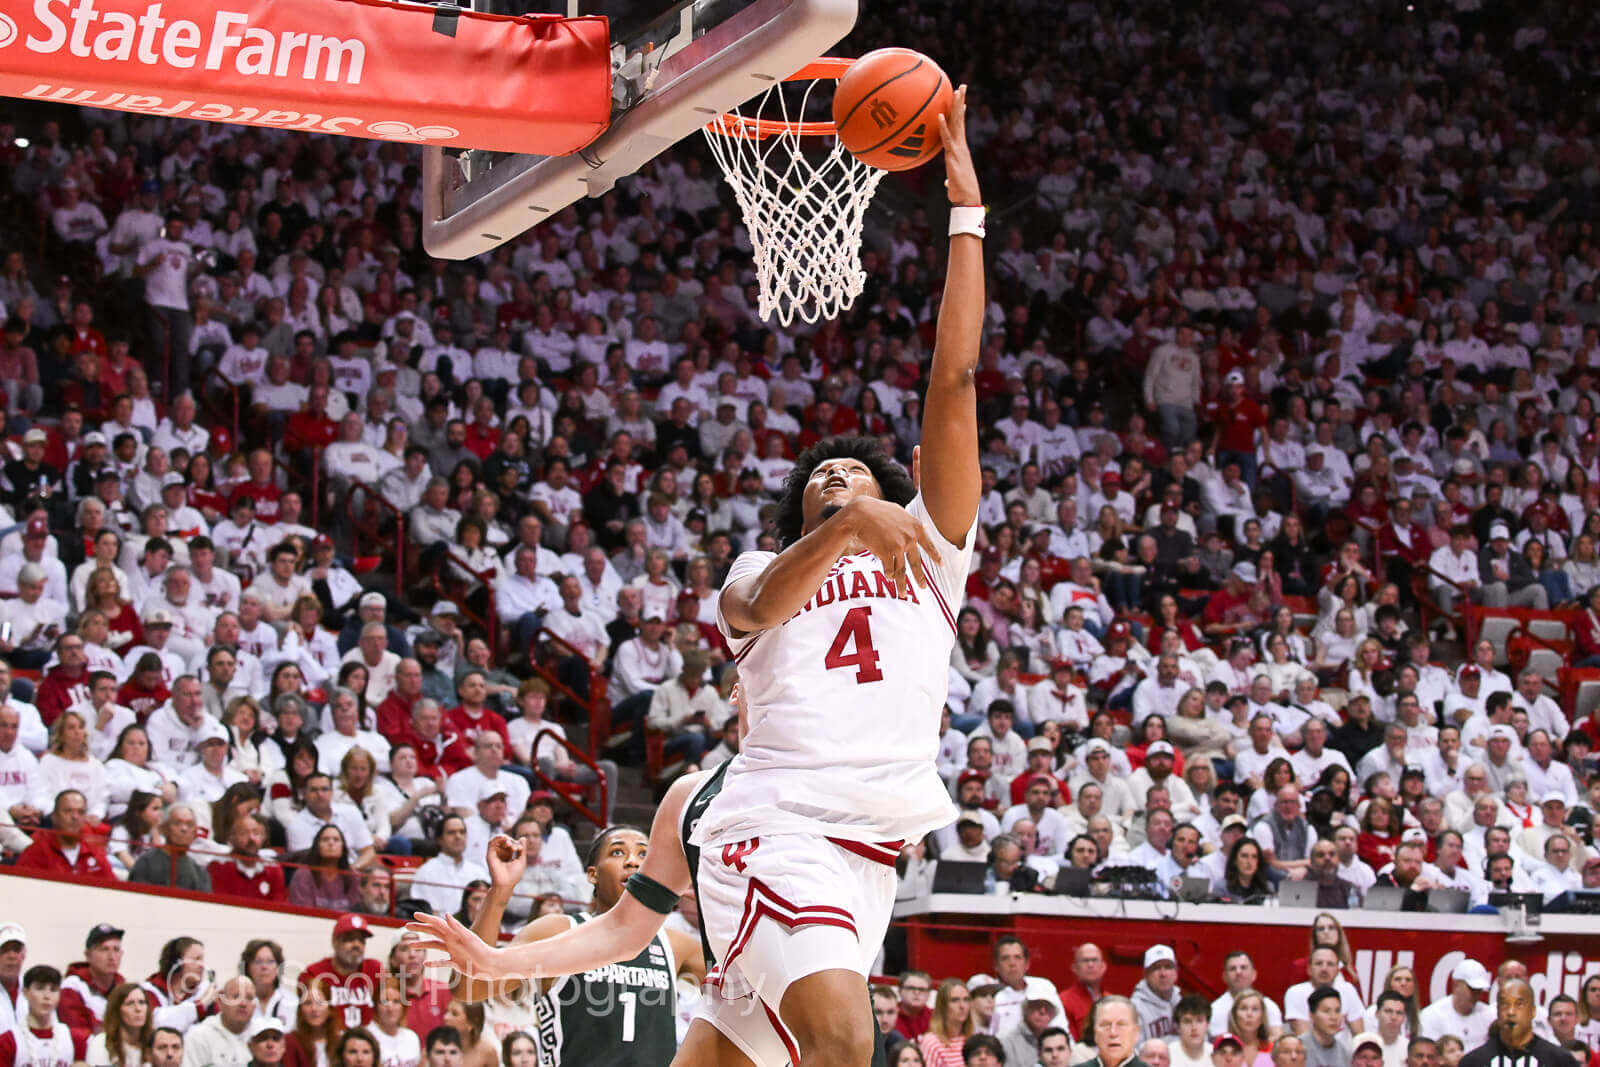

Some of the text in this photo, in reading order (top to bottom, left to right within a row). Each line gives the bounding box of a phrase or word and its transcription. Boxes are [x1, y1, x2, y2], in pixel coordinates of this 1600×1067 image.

[782, 569, 921, 626] DIANA
[825, 605, 884, 684] 4
[583, 963, 670, 990] SPARTANS
[618, 991, 638, 1043] 1
